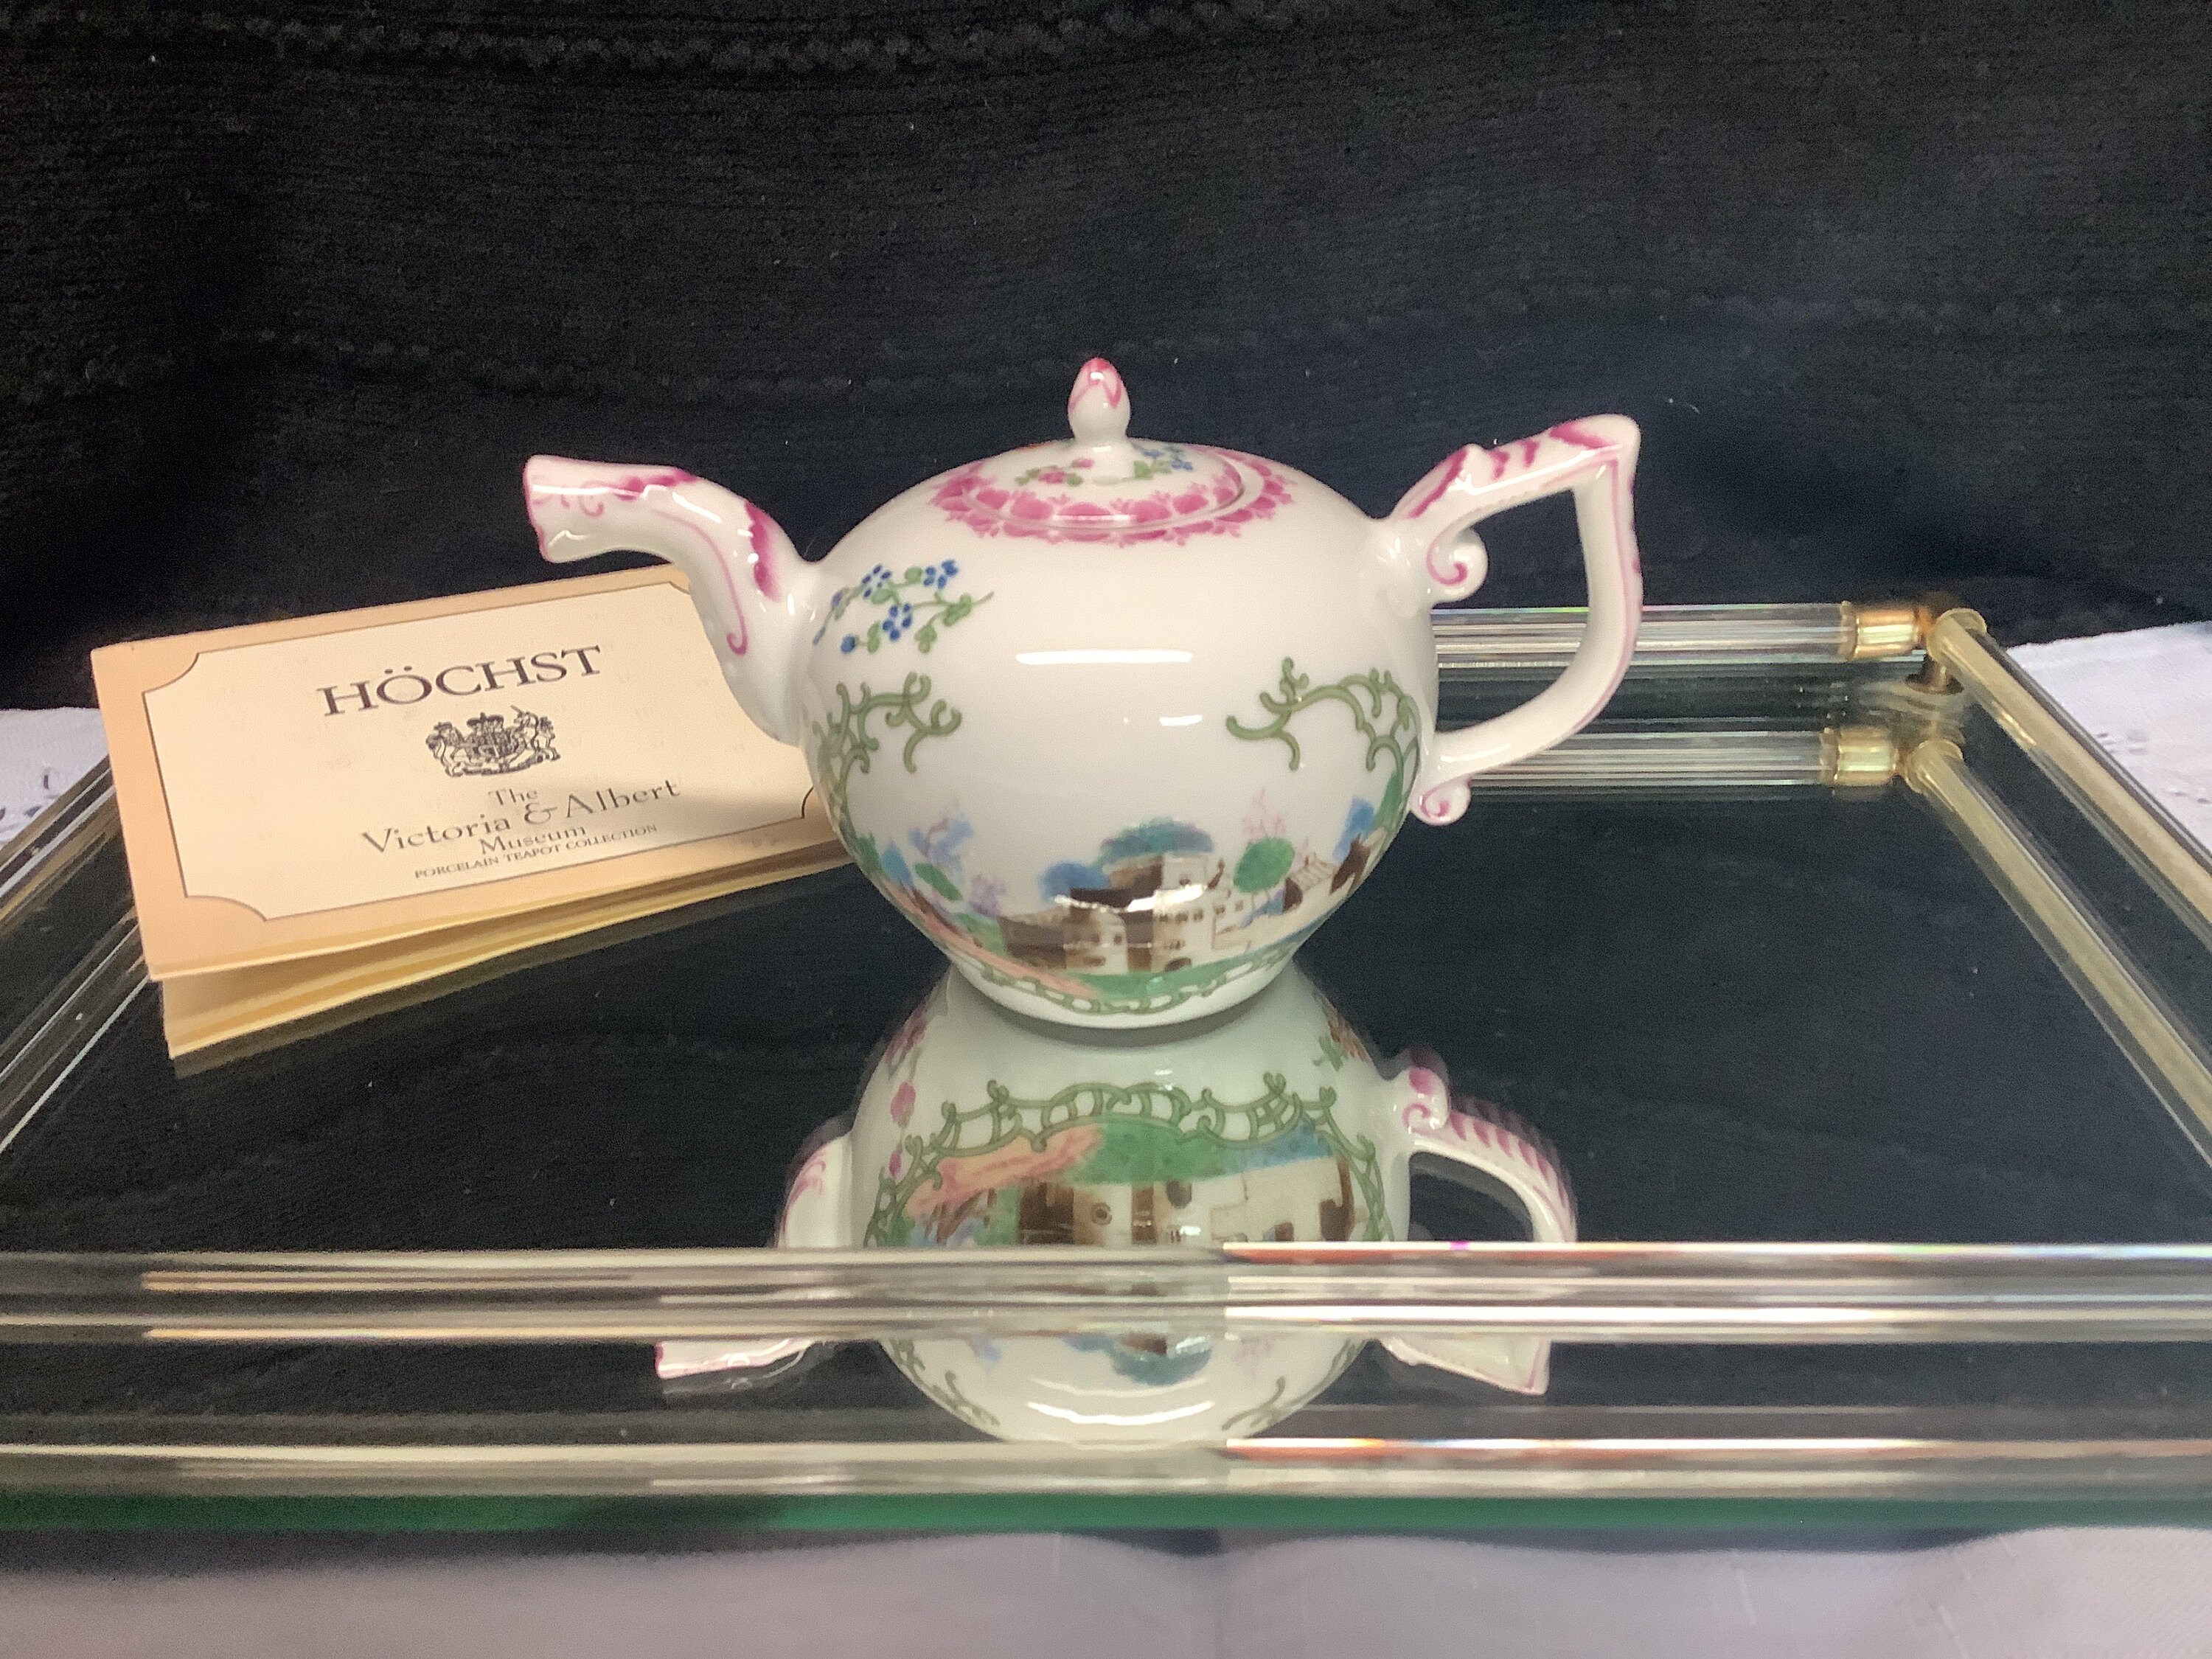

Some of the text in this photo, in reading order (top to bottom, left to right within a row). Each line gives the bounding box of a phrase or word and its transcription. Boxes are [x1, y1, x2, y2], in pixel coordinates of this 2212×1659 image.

[316, 645, 600, 717] HÖCHST
[361, 779, 681, 853] Victoria & Albert
[488, 788, 538, 807] The
[414, 824, 658, 879] PORCELAIN TEAPOT COLLECTION
[479, 826, 587, 855] Museum
